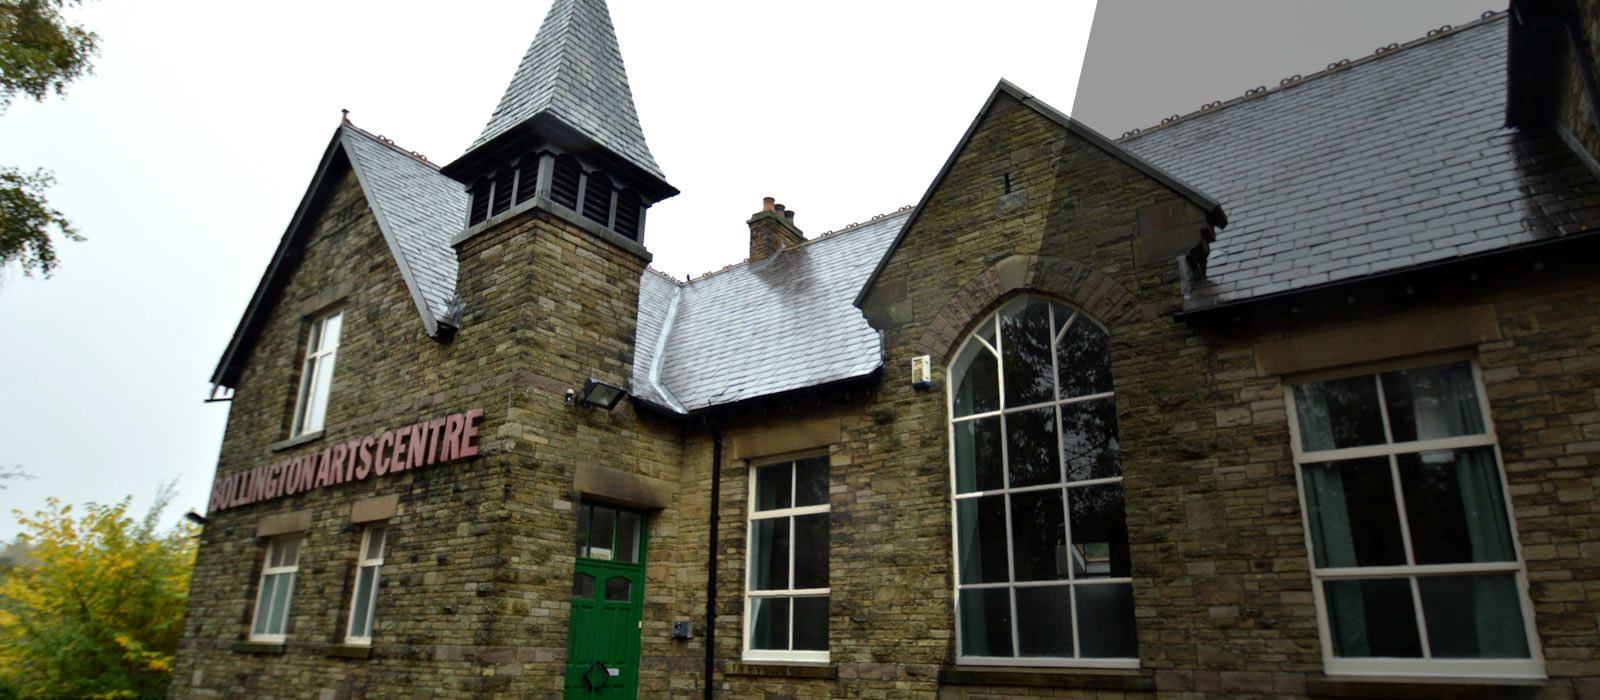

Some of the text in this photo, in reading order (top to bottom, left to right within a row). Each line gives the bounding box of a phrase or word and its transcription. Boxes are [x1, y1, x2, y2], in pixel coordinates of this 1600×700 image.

[208, 408, 485, 512] BOLLINGTON ARTS CENTRE
